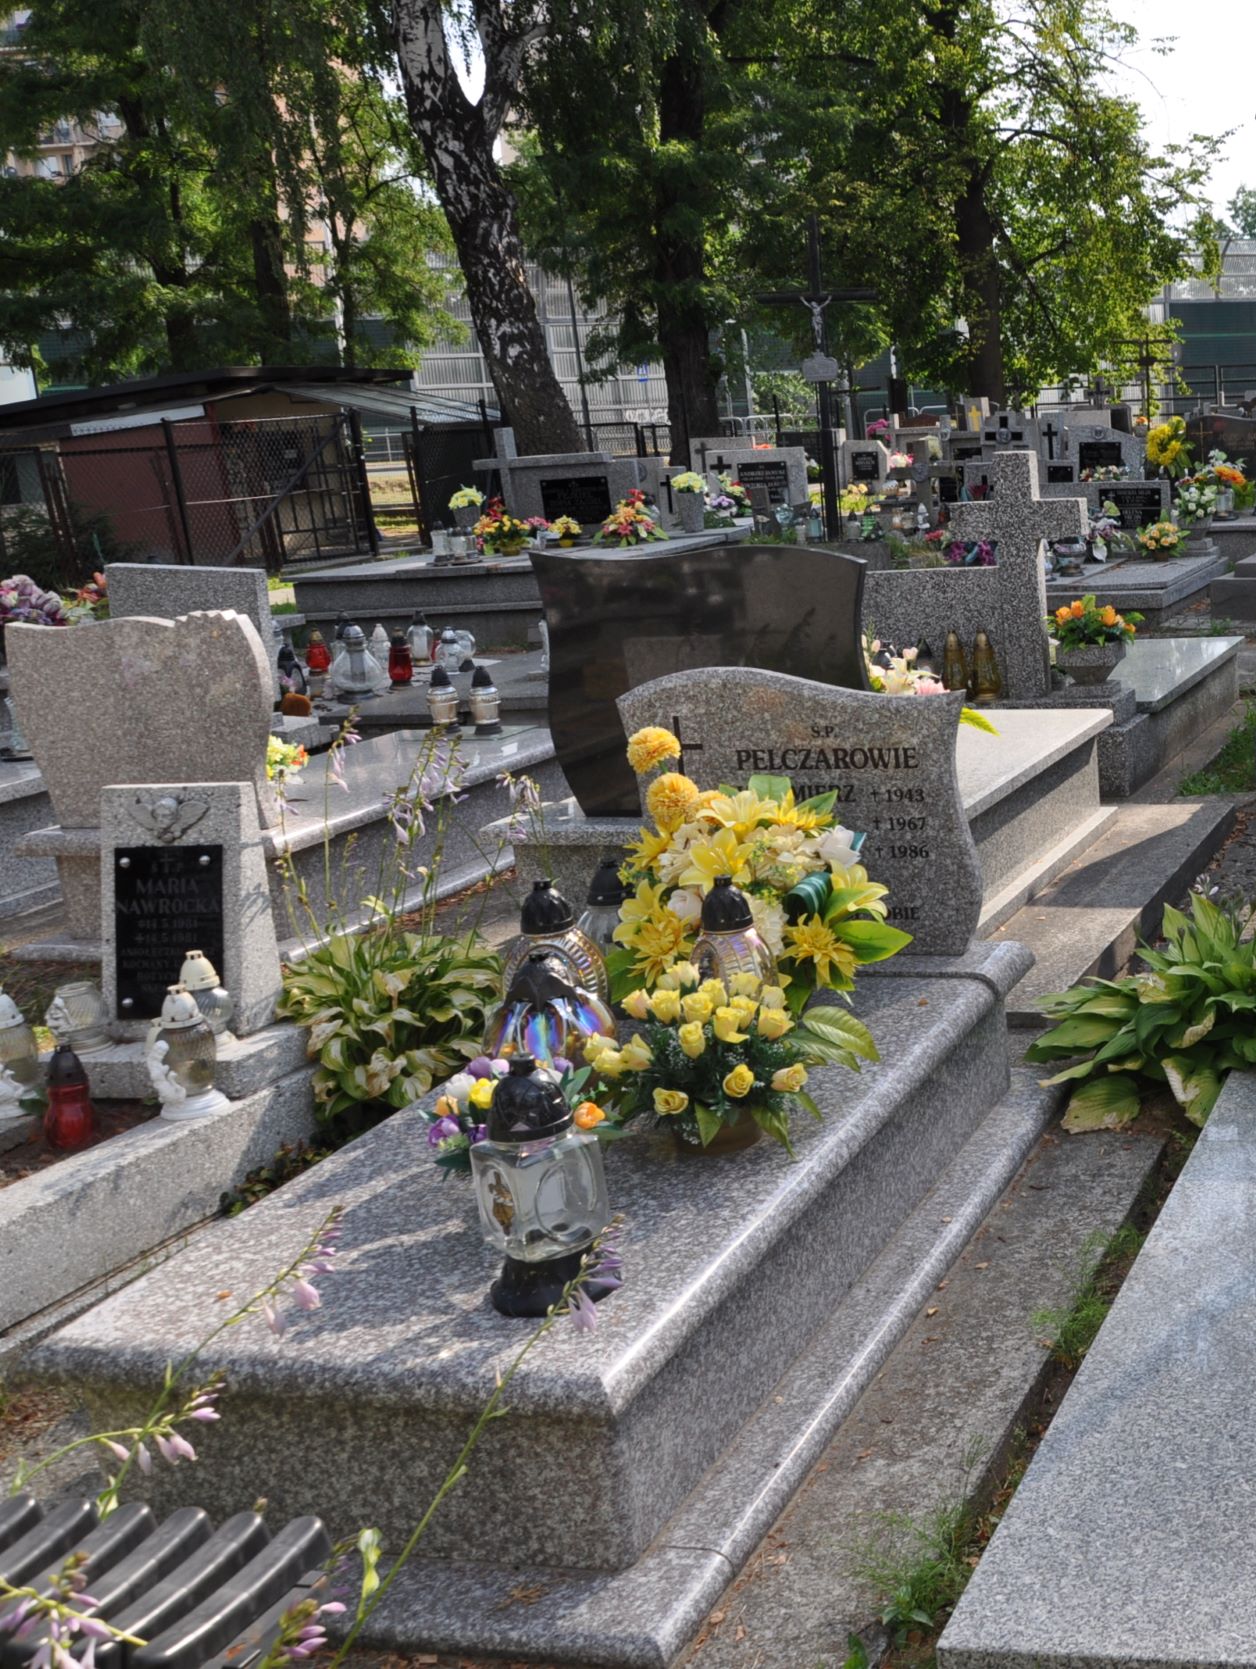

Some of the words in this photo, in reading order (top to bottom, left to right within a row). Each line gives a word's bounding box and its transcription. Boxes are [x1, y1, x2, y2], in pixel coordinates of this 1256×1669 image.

[736, 746, 921, 770] PELCZAROWIE
[888, 816, 926, 831] 1967
[890, 844, 929, 860] 1986
[136, 878, 199, 894] MARIA
[116, 898, 221, 916] NAWROCKA
